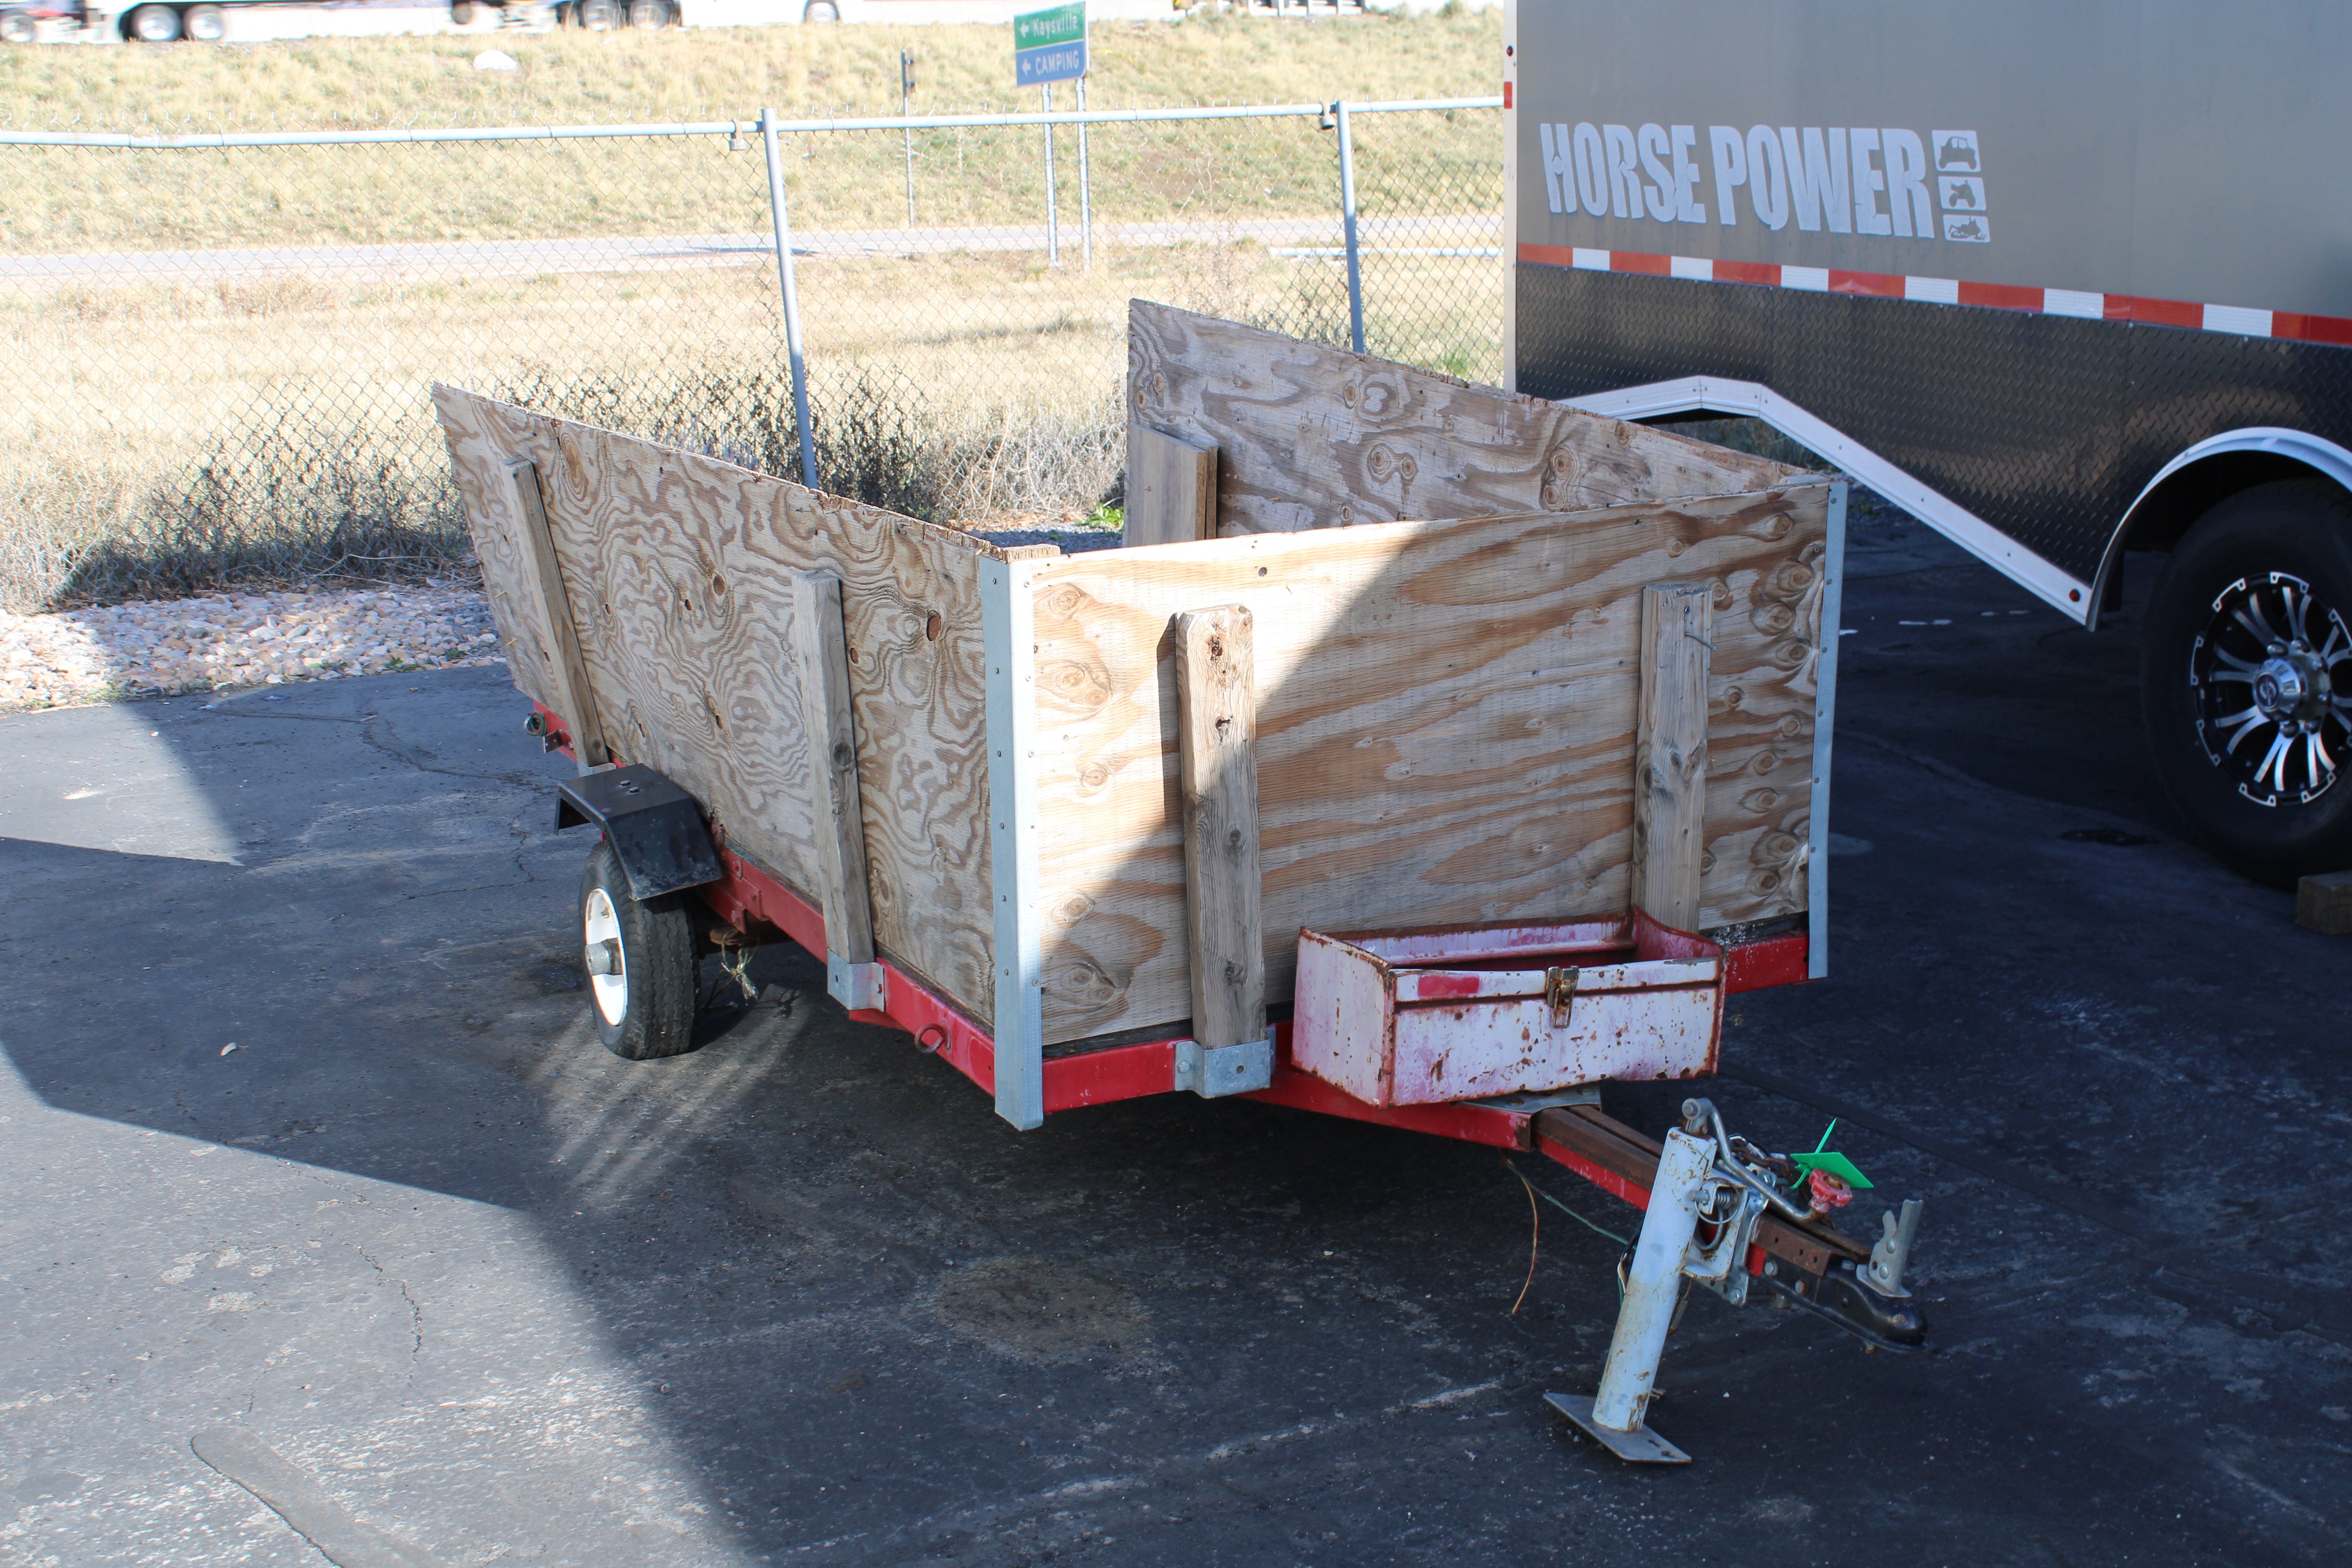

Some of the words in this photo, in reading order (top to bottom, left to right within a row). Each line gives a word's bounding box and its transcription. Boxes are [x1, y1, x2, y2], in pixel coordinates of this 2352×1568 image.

[1033, 12, 1078, 40] Kaysville
[1035, 49, 1079, 75] CAMPING
[1540, 122, 1706, 224] HORSE
[1709, 125, 1935, 239] POWER
